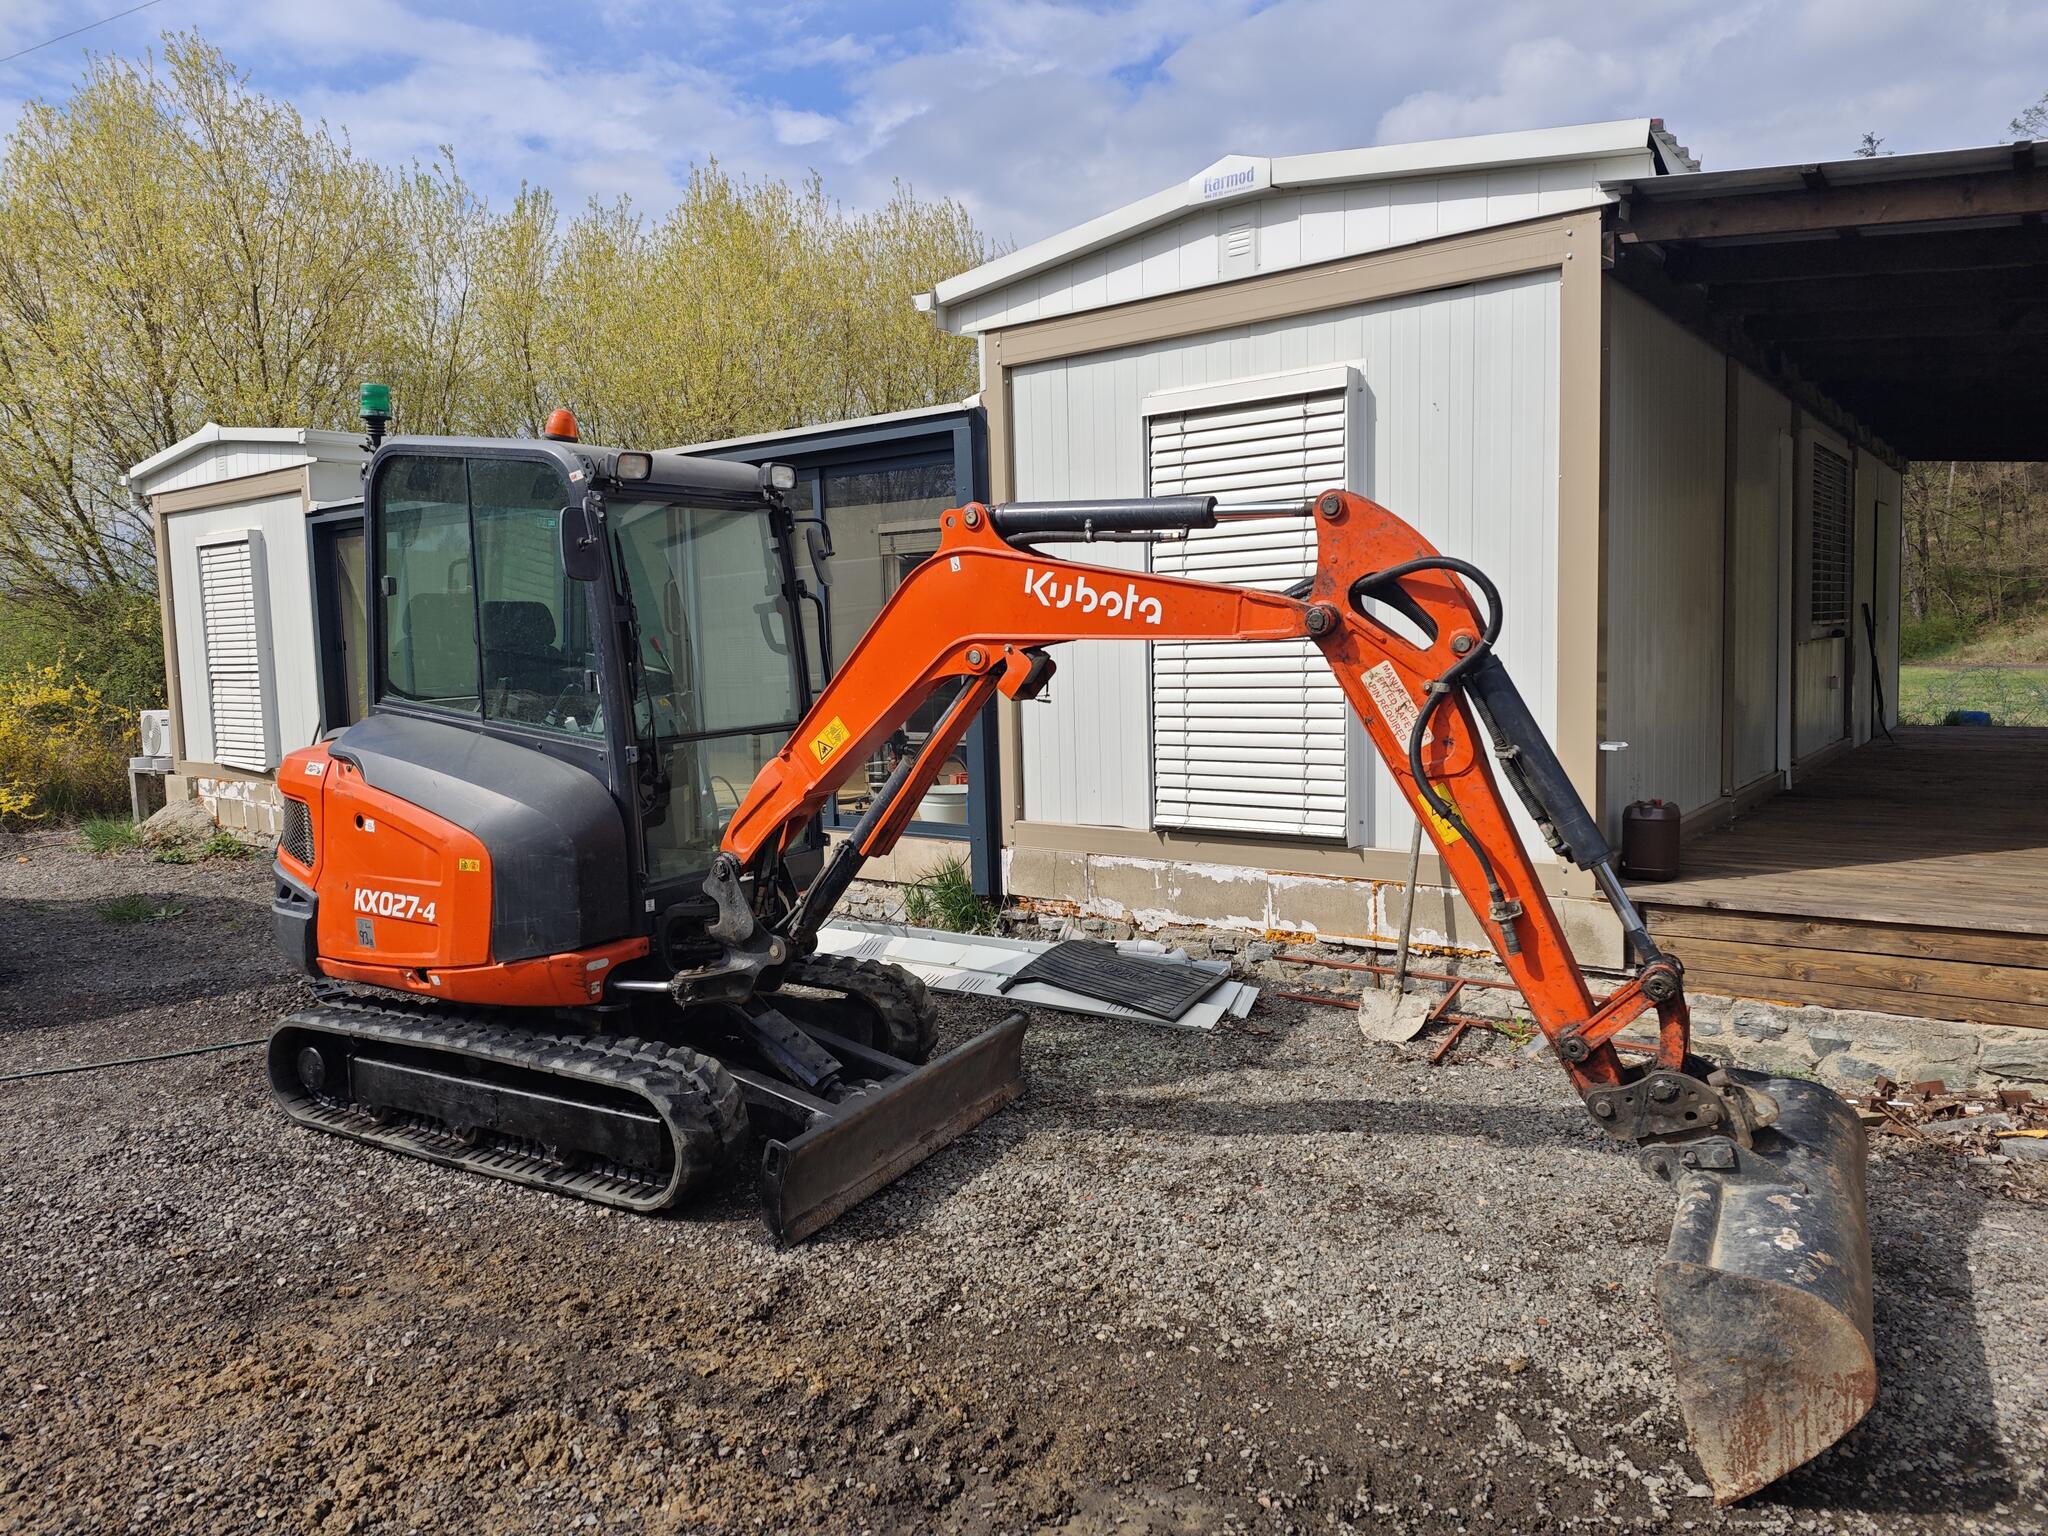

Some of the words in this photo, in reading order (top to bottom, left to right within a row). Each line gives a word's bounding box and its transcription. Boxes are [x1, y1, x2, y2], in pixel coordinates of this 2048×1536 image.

[1204, 166, 1254, 194] Karmod
[1024, 568, 1163, 625] Kubota
[1378, 699, 1407, 742] REQUIRED
[1382, 664, 1406, 700] MANUAL
[1404, 699, 1431, 740] COUR
[354, 888, 436, 922] KX027-4
